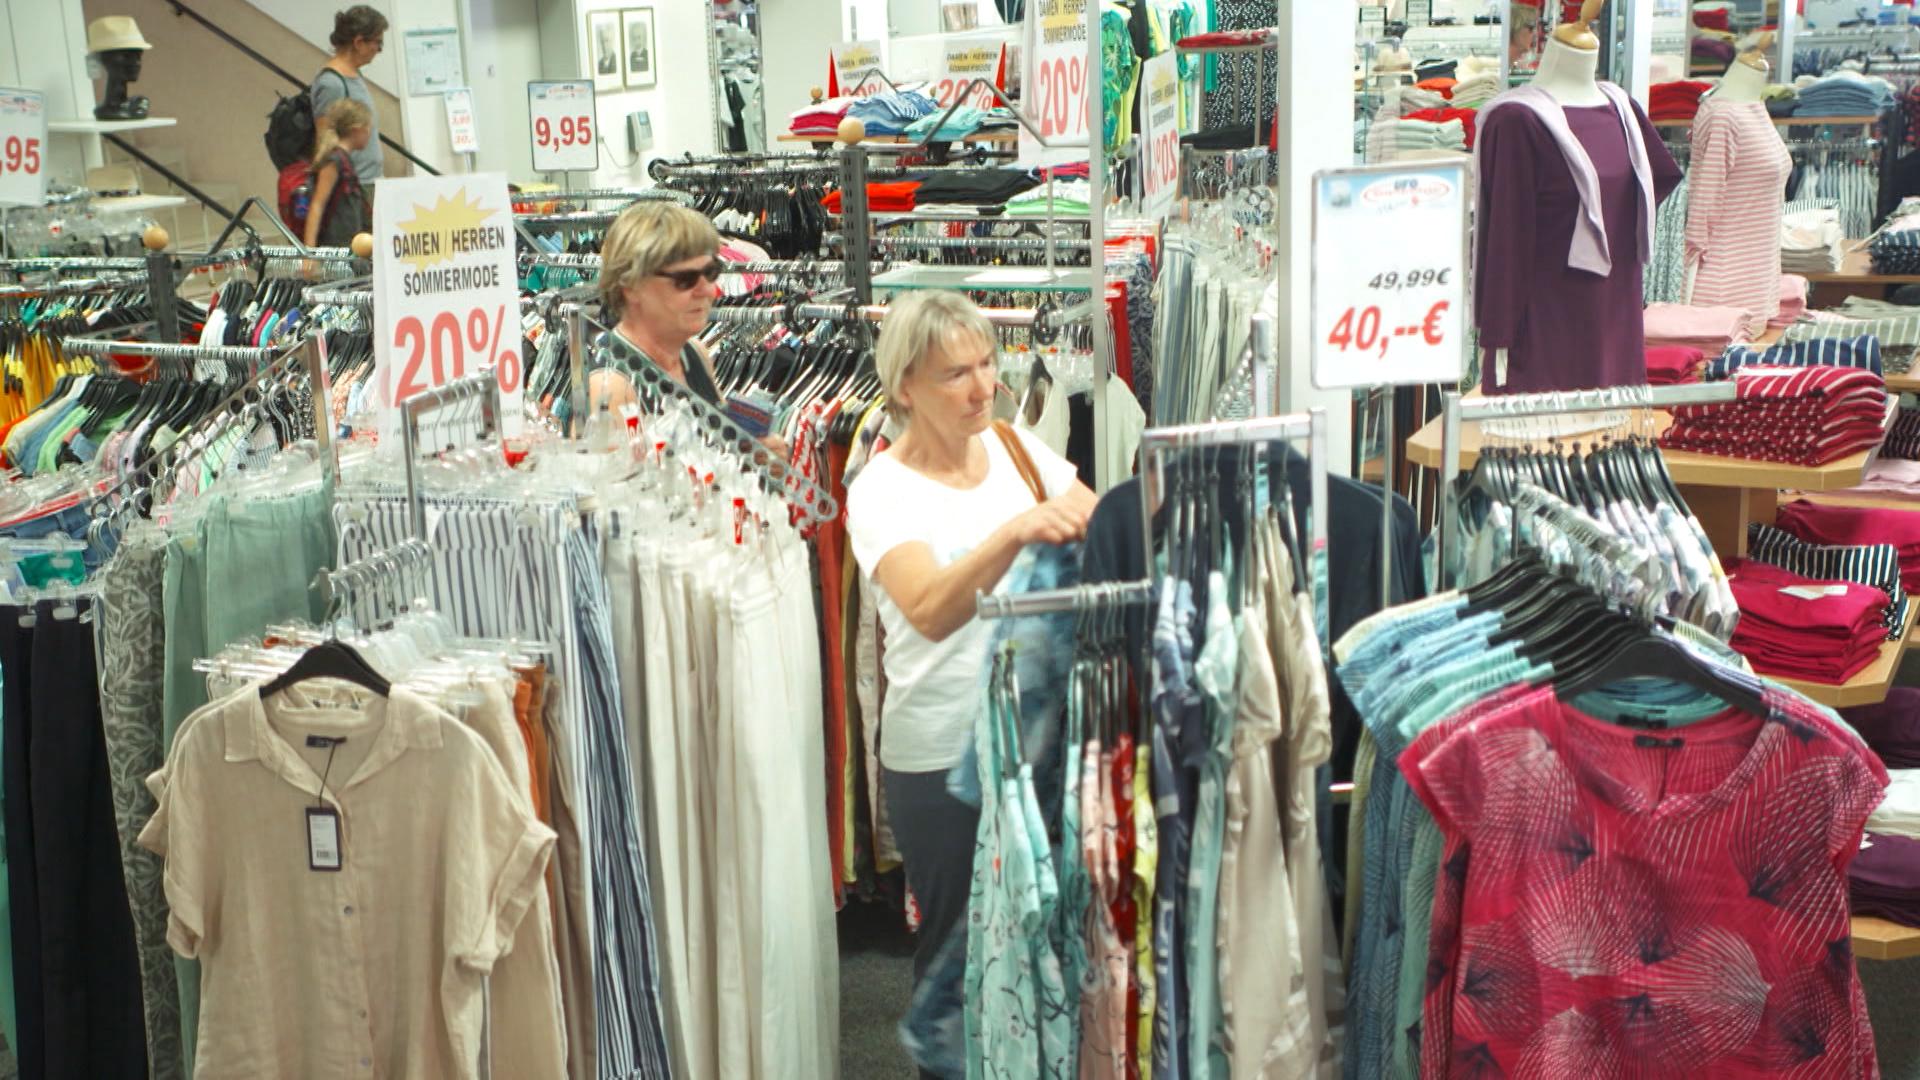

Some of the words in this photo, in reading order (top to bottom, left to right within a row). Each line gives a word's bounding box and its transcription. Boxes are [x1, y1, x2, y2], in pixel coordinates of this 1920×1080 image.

[938, 79, 992, 111] 20%
[1040, 55, 1089, 137] 20%
[535, 115, 592, 153] 9,95
[393, 231, 440, 258] DAMEN
[451, 226, 505, 252] HERREN
[404, 264, 500, 296] SOMMERMODE
[1368, 267, 1451, 292] 49,99€
[1327, 299, 1450, 359] 40,--€
[394, 304, 520, 408] 20%
